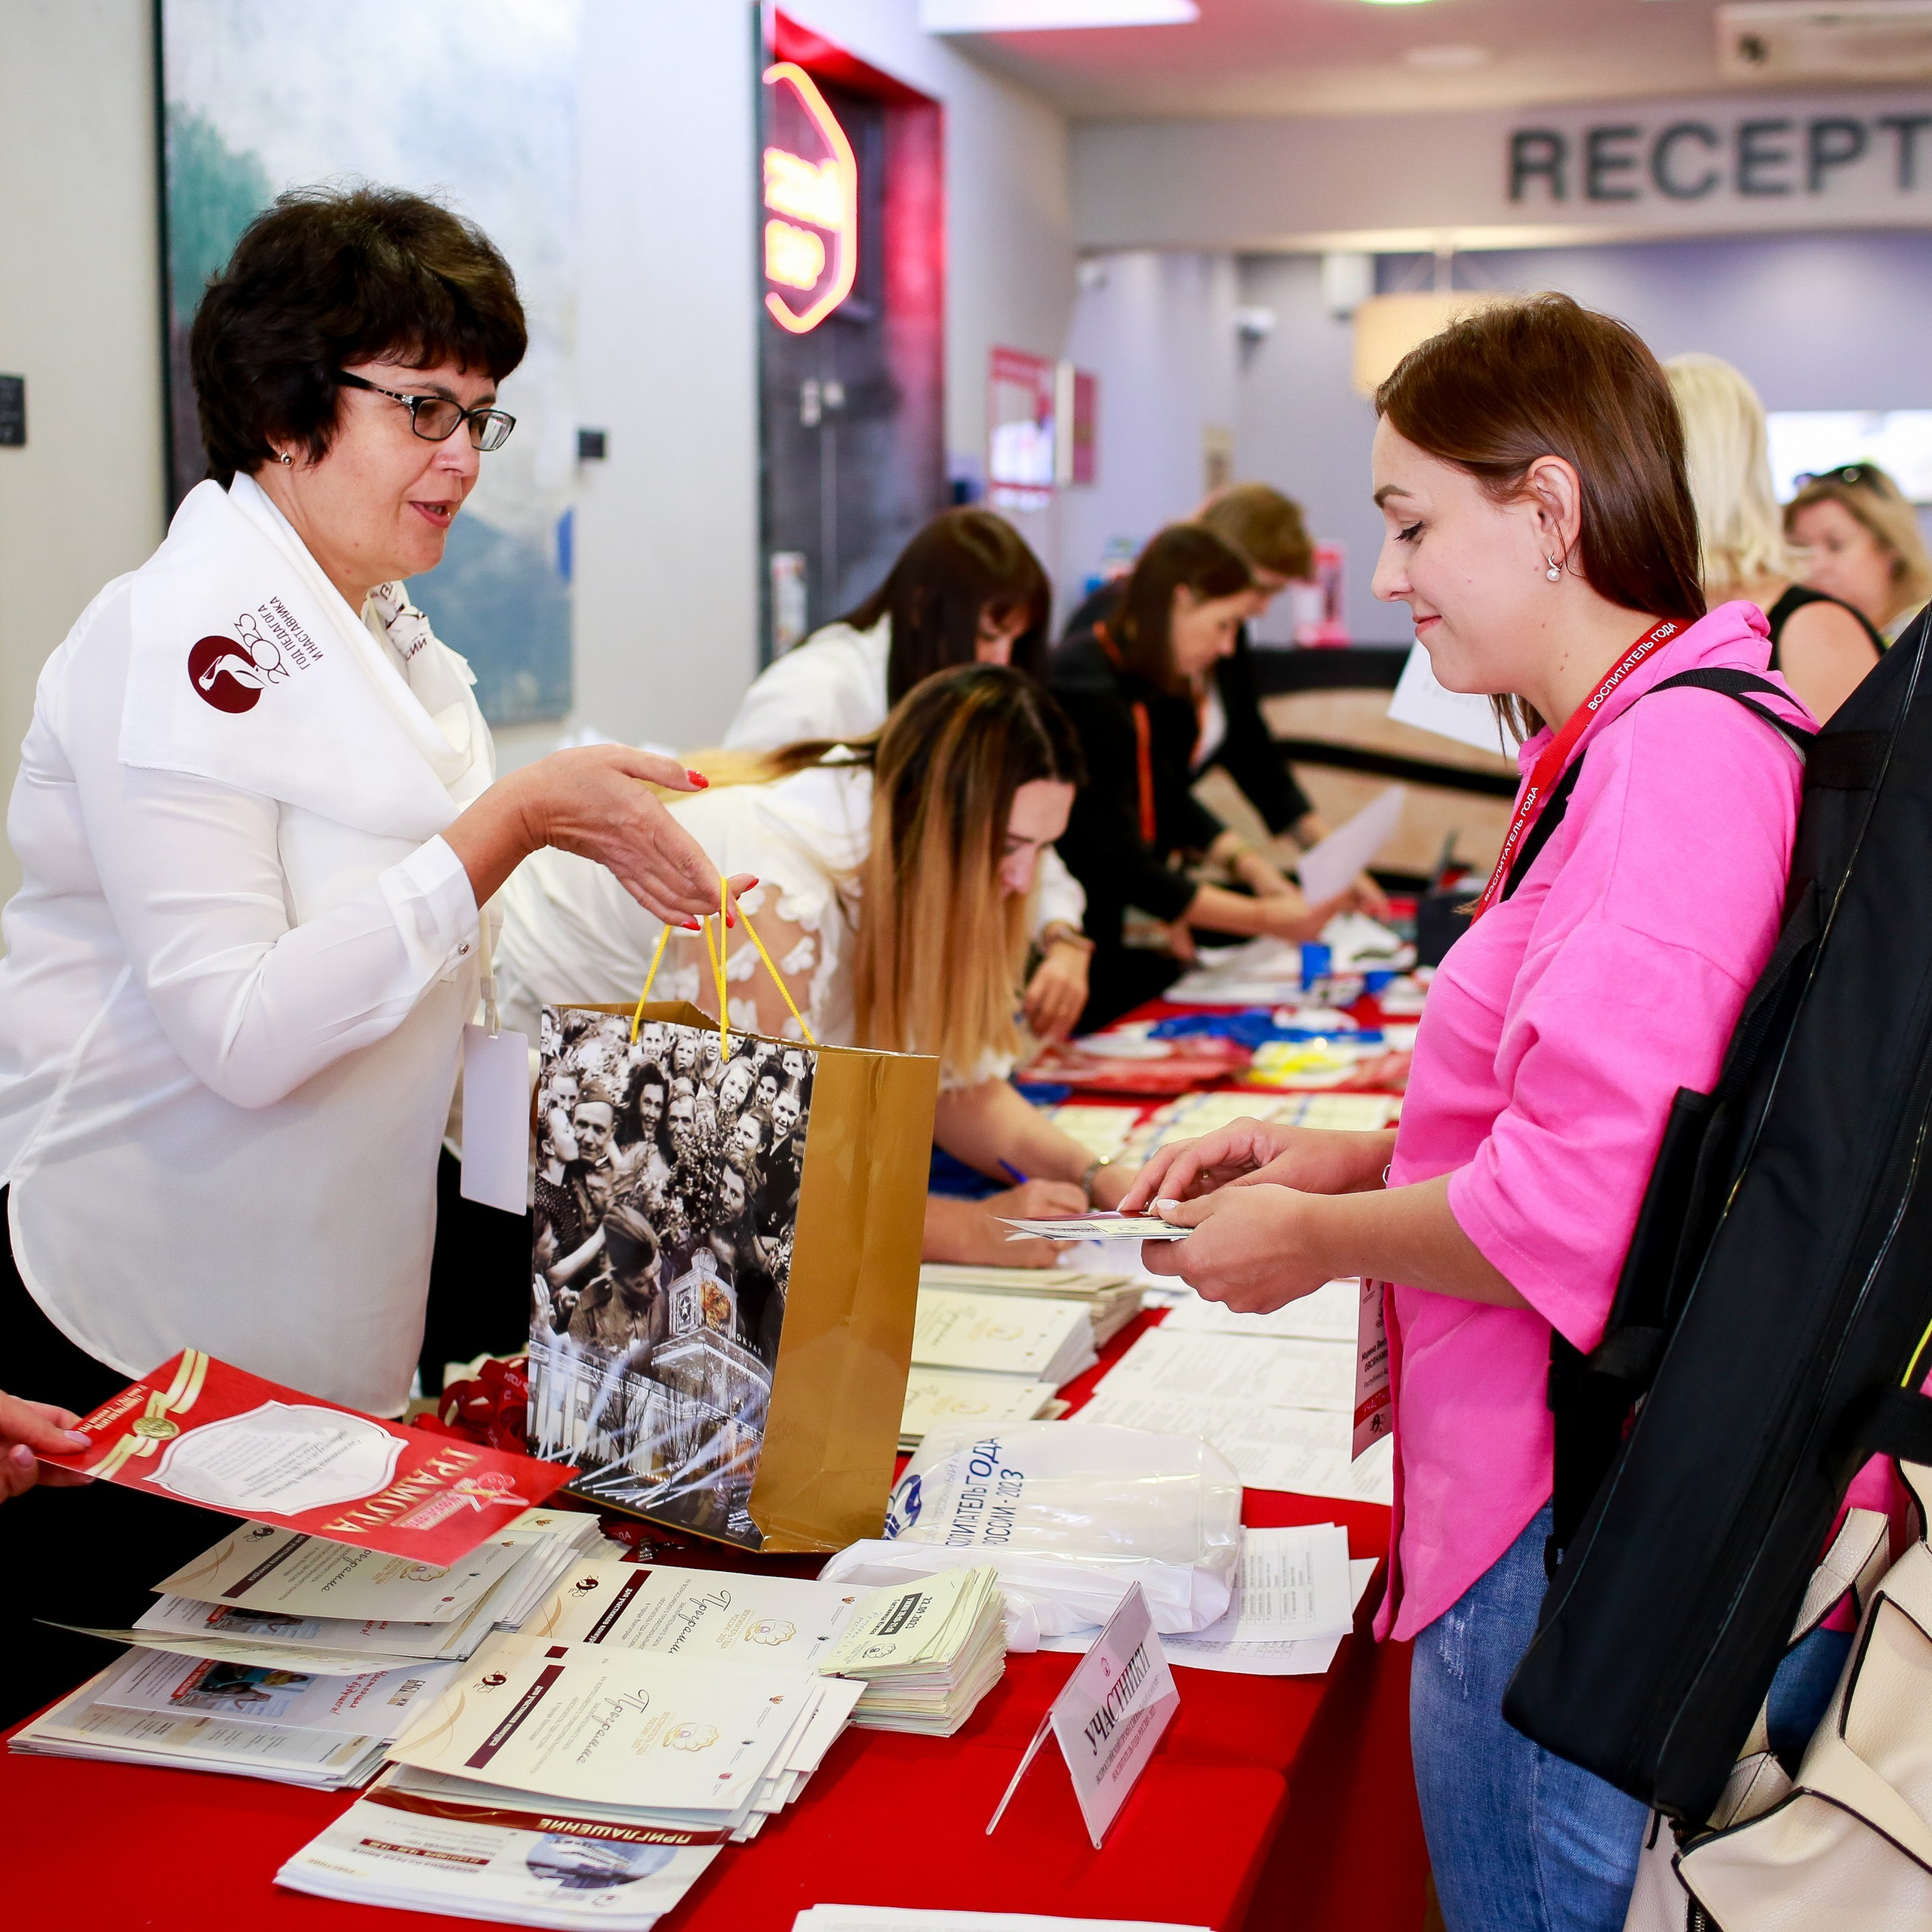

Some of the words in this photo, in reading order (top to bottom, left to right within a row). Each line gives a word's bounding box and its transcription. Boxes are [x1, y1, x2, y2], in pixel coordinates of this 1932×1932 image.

[1509, 112, 1932, 205] RECEPT
[257, 604, 296, 651] ПЕДАГОГА
[269, 595, 318, 654] НАСТАВНИКА
[291, 649, 311, 670] ГОД
[314, 652, 325, 662] И
[1587, 641, 1654, 711] ВОСПИТАТЕЛЬ
[1650, 621, 1678, 645] ГОДА
[1484, 819, 1524, 902] ВОСПИТАТЕЛЬ
[1521, 786, 1539, 817] ГОДА
[321, 1447, 481, 1534] ГРАМОТА
[965, 1438, 1001, 1484] ГОДА
[321, 1549, 372, 1592] рограмма
[668, 1589, 731, 1655] Программ
[575, 1688, 651, 1764] Программа
[1084, 1639, 1151, 1761] УЧАСТНИКИ
[534, 1817, 693, 1844] ПРИГЛАШЕНИЕ
